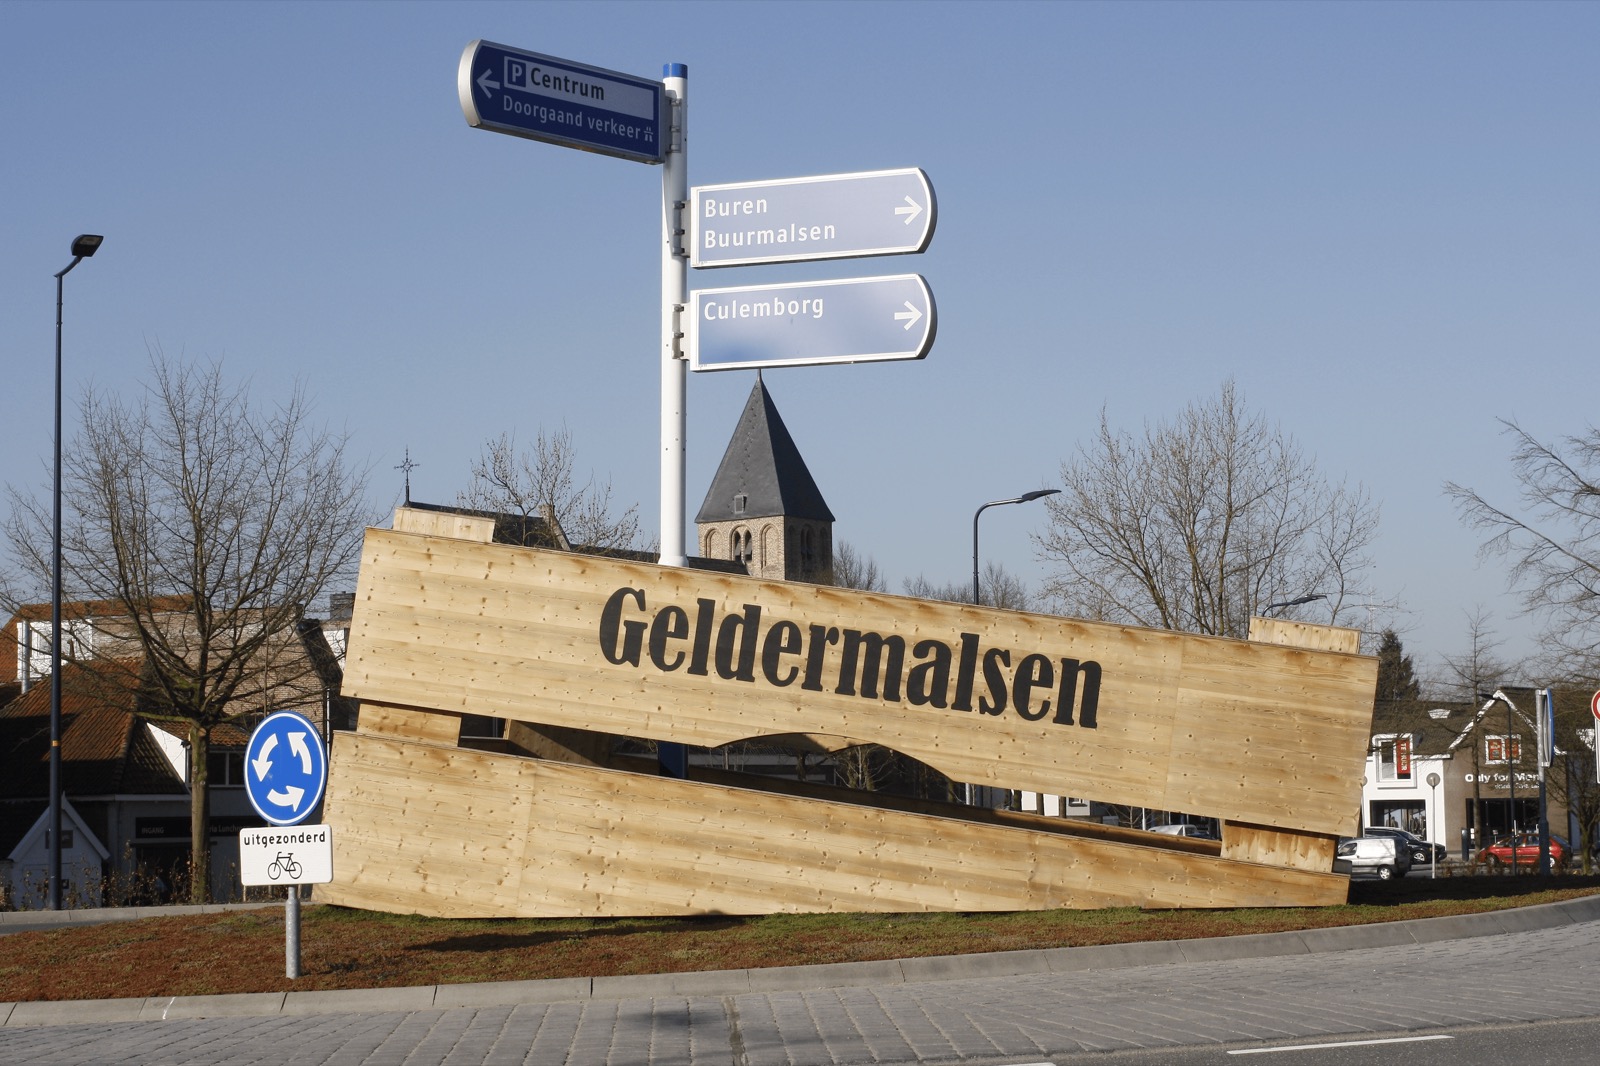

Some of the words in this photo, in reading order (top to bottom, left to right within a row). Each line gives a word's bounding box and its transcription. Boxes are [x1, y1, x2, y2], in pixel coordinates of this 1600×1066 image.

[511, 63, 523, 83] P
[530, 67, 605, 100] Centrum
[503, 94, 583, 127] Doorgaand
[587, 116, 641, 140] verkeer
[705, 198, 767, 218] Buren
[704, 223, 835, 249] Buurmalsen
[704, 297, 824, 320] Culemborg
[599, 586, 1102, 728] Geldermalsen
[244, 831, 326, 848] uitgezonderd
